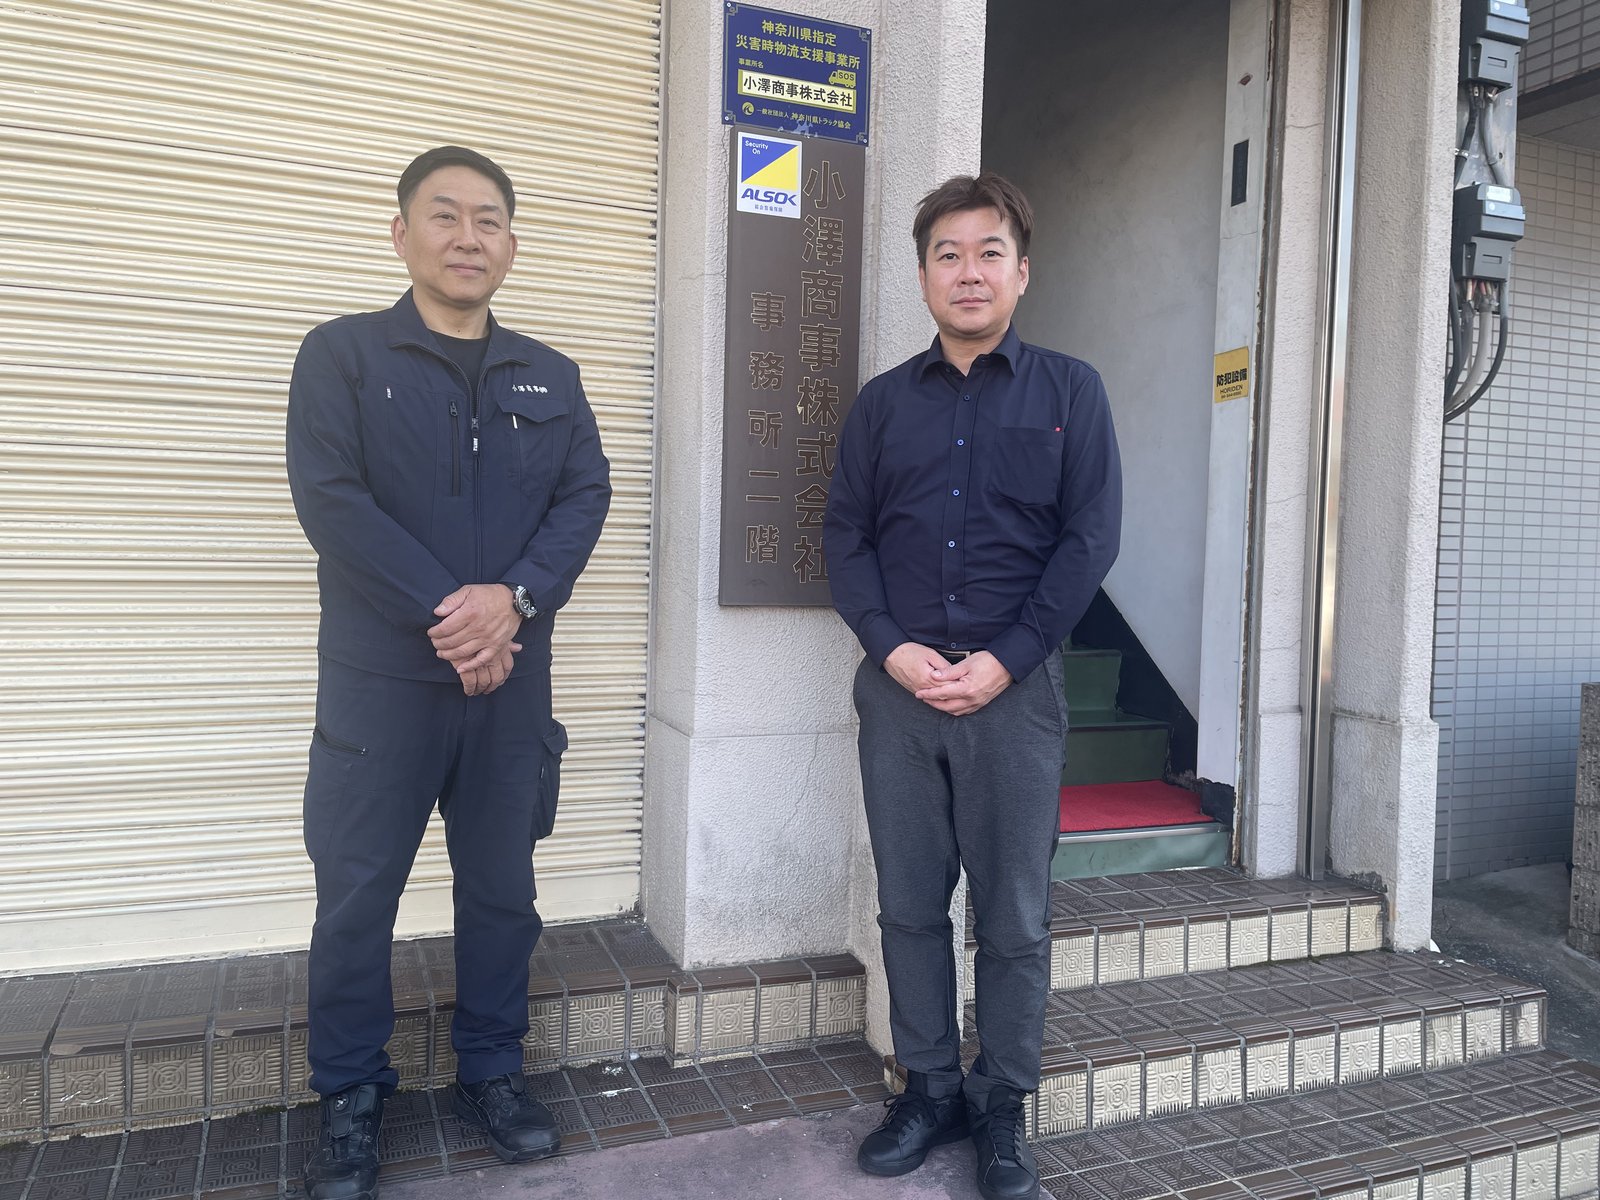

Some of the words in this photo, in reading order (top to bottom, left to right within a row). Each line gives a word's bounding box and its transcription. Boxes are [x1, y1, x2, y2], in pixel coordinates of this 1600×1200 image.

[761, 19, 837, 47] 神奈川県指定
[735, 33, 861, 70] 災害時物流支援事業所
[838, 71, 855, 82] SOS
[743, 75, 853, 107] 小澤商事株式会社
[745, 140, 769, 150] Security
[752, 147, 761, 155] On
[741, 188, 798, 207] ALSOK
[792, 160, 846, 585] 小澤商事株式会社
[745, 290, 787, 565] 事務所二階
